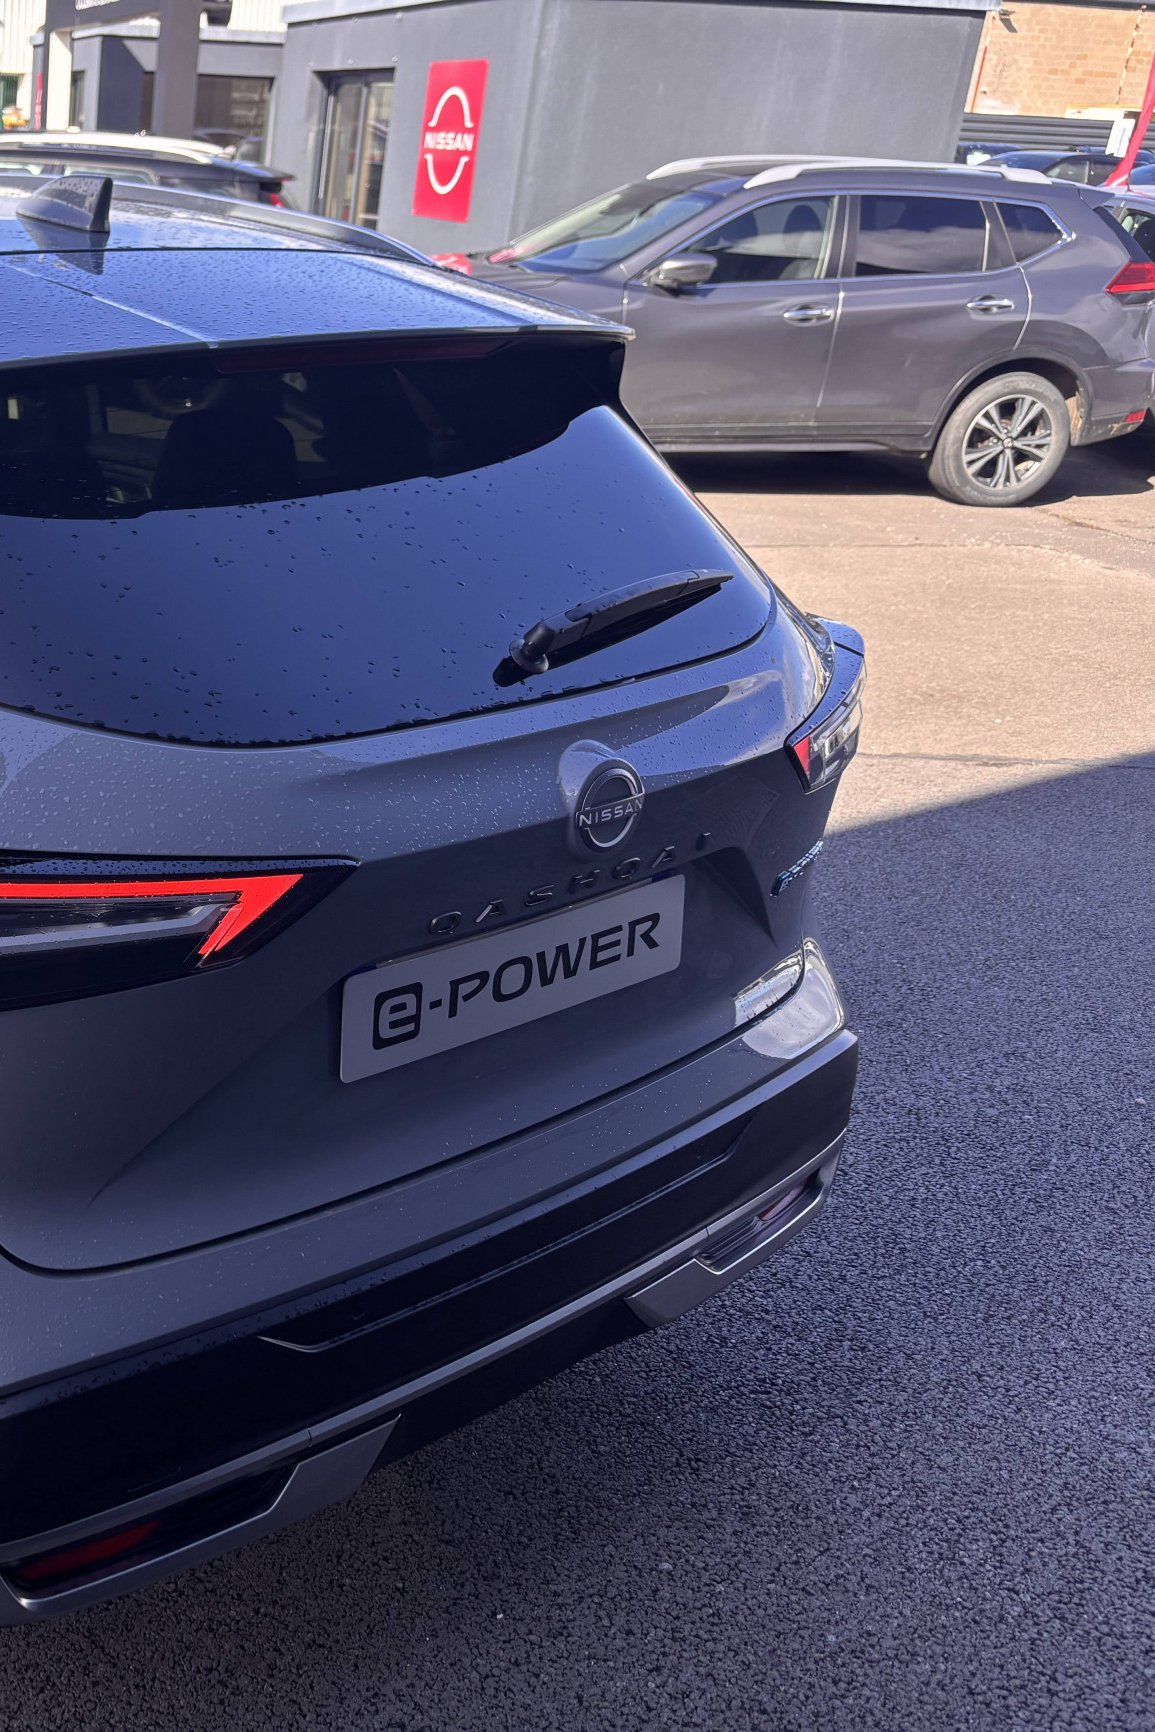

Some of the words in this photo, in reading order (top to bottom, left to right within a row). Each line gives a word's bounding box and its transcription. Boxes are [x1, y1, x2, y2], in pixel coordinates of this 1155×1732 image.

[424, 132, 475, 151] NISSAN
[579, 799, 643, 826] NISSAN
[372, 912, 661, 1051] e-POWER
